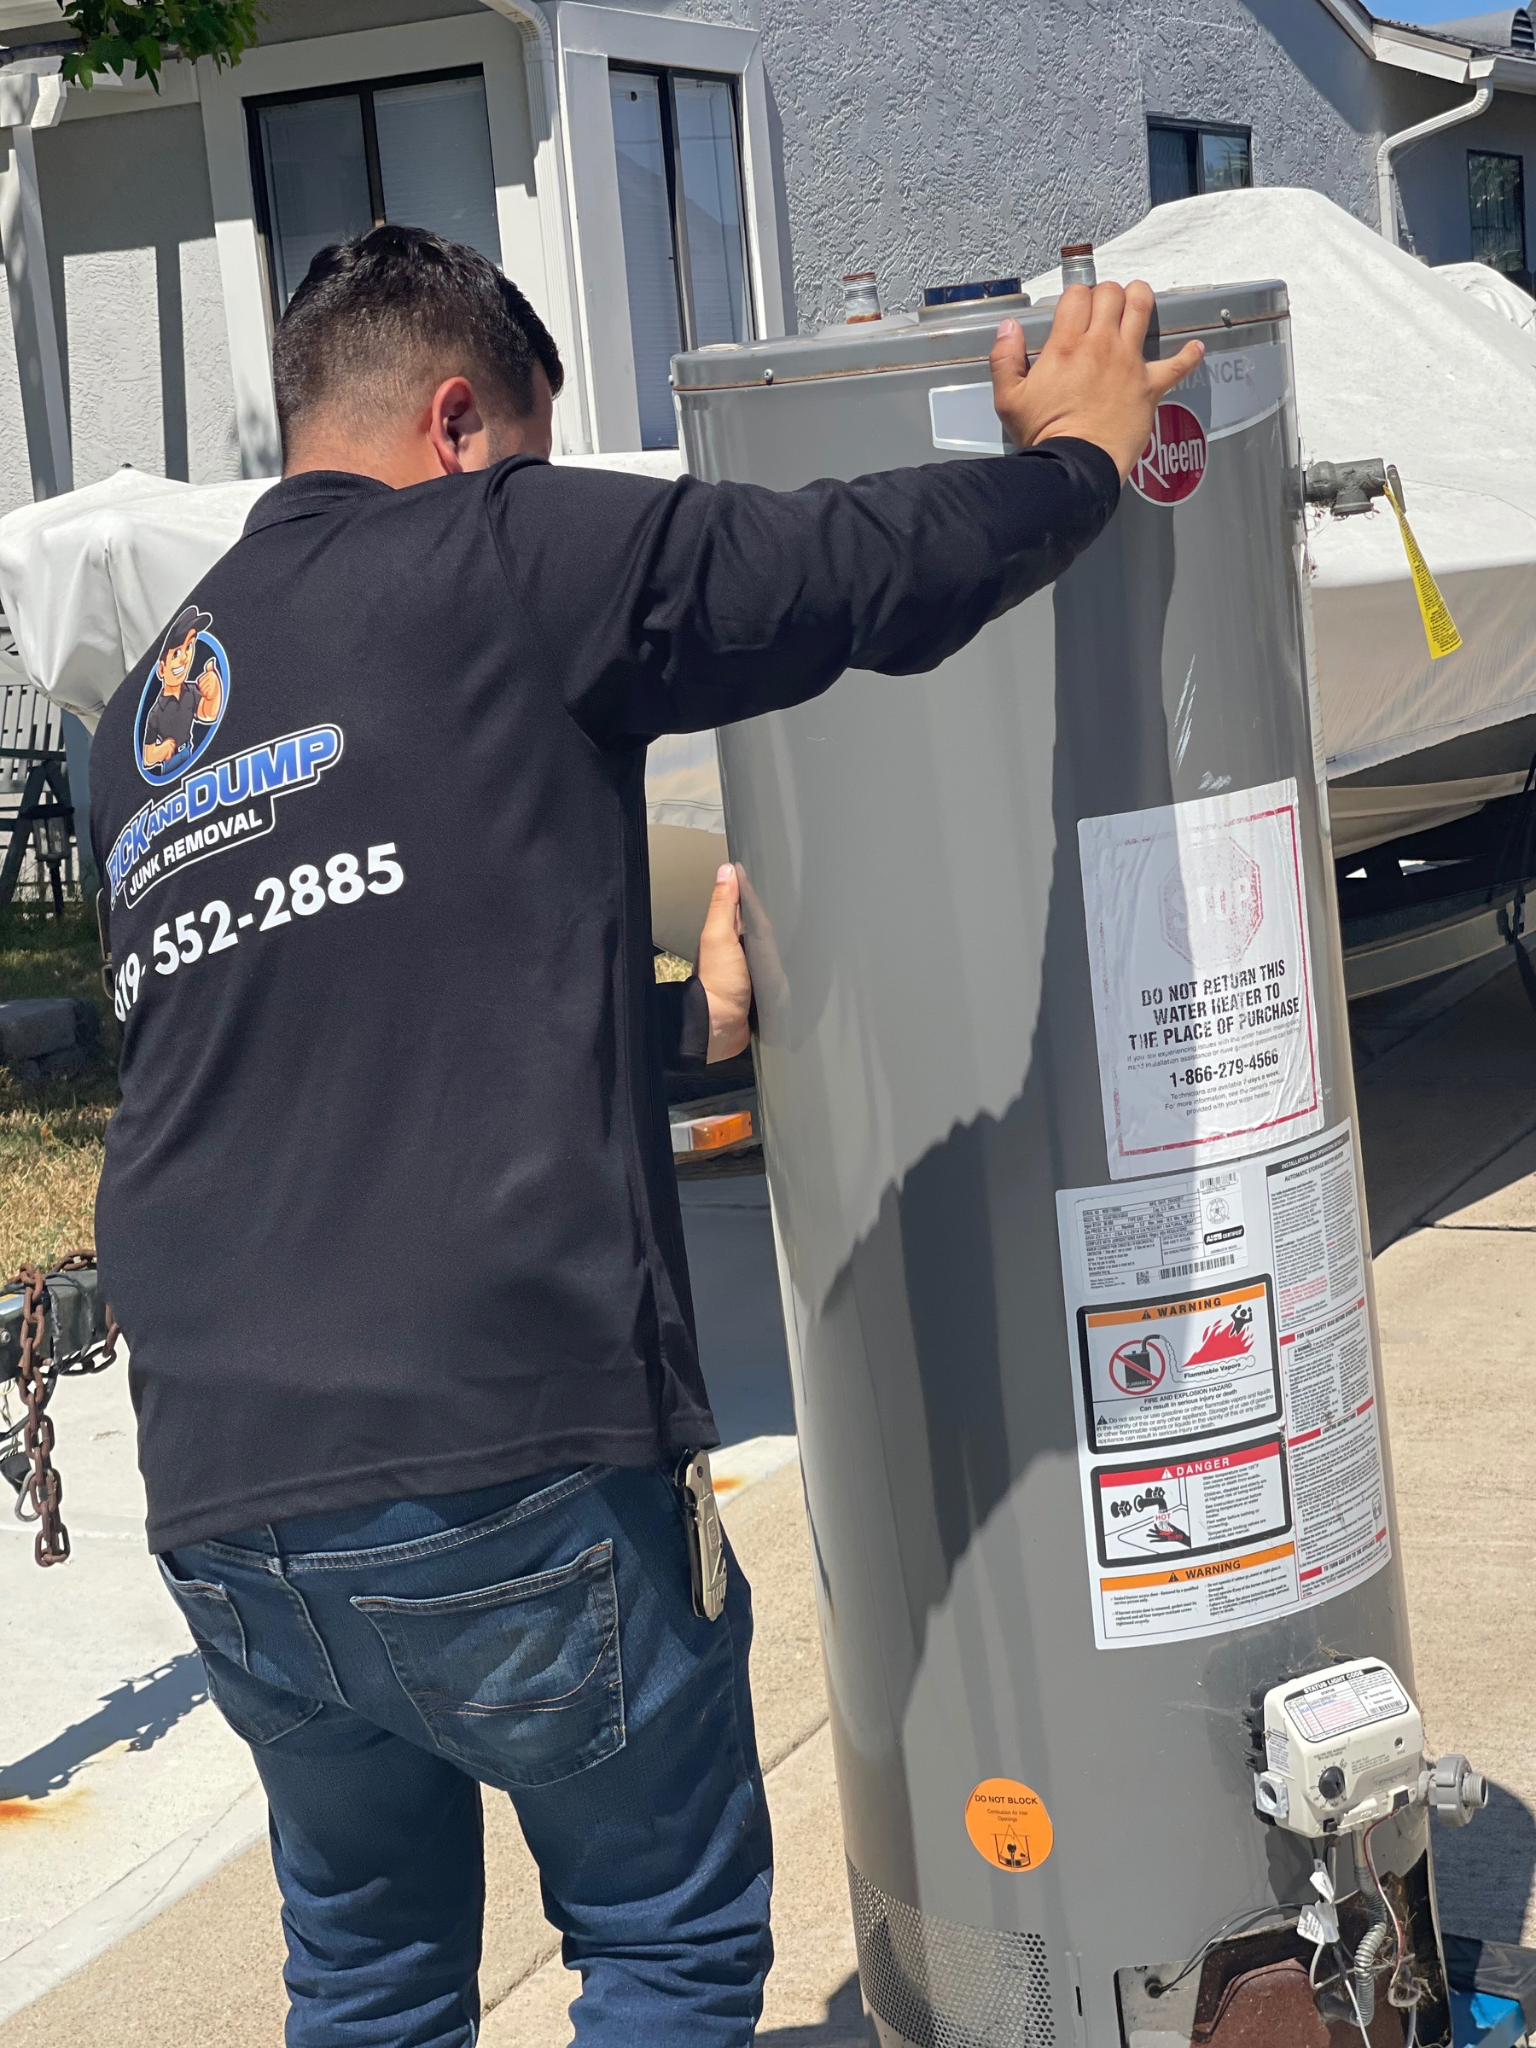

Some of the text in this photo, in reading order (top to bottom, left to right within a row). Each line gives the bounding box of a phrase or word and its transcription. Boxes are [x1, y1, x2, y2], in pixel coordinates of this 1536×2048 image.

[1137, 406, 1204, 489] Rheem
[147, 798, 186, 841] AND
[186, 729, 339, 822] DUMP
[130, 809, 262, 895] JUNK REMOVAL
[154, 842, 404, 976] 552-2885
[1142, 960, 1285, 1006] DO NOT RETURN THIS
[1154, 983, 1280, 1026] WATER HEATER TO
[1129, 1031, 1158, 1050] THE
[1164, 1021, 1212, 1045] PLACE
[1217, 1016, 1234, 1035] OF
[1239, 997, 1299, 1030] PURCHASE
[1158, 1045, 1197, 1058] experiencing
[1170, 1048, 1279, 1088] 1-866-279-4566
[1171, 1089, 1205, 1100] Technicians
[1187, 1104, 1212, 1116] provided
[1157, 1298, 1222, 1318] WARNING
[1184, 1363, 1241, 1379] Flammable Vapors
[1153, 1402, 1170, 1410] result
[1178, 1398, 1198, 1407] serious
[1199, 1394, 1215, 1403] injury
[1223, 1389, 1238, 1397] death
[1174, 1389, 1208, 1400] EXPLOSION
[1209, 1383, 1233, 1393] HAZARD
[1161, 1409, 1184, 1418] gasoline
[1205, 1399, 1231, 1409] flammable
[1209, 1407, 1229, 1415] Storage
[1120, 1427, 1148, 1436] flammable
[1177, 1458, 1230, 1476] DANGER
[1156, 1513, 1171, 1521] HOT
[1186, 1560, 1241, 1580] WARNING
[1304, 1682, 1328, 1694] STATUS
[1328, 1675, 1346, 1687] LIGHT
[1346, 1670, 1365, 1680] CODE
[975, 1795, 1038, 1805] DO NOT BLOCK
